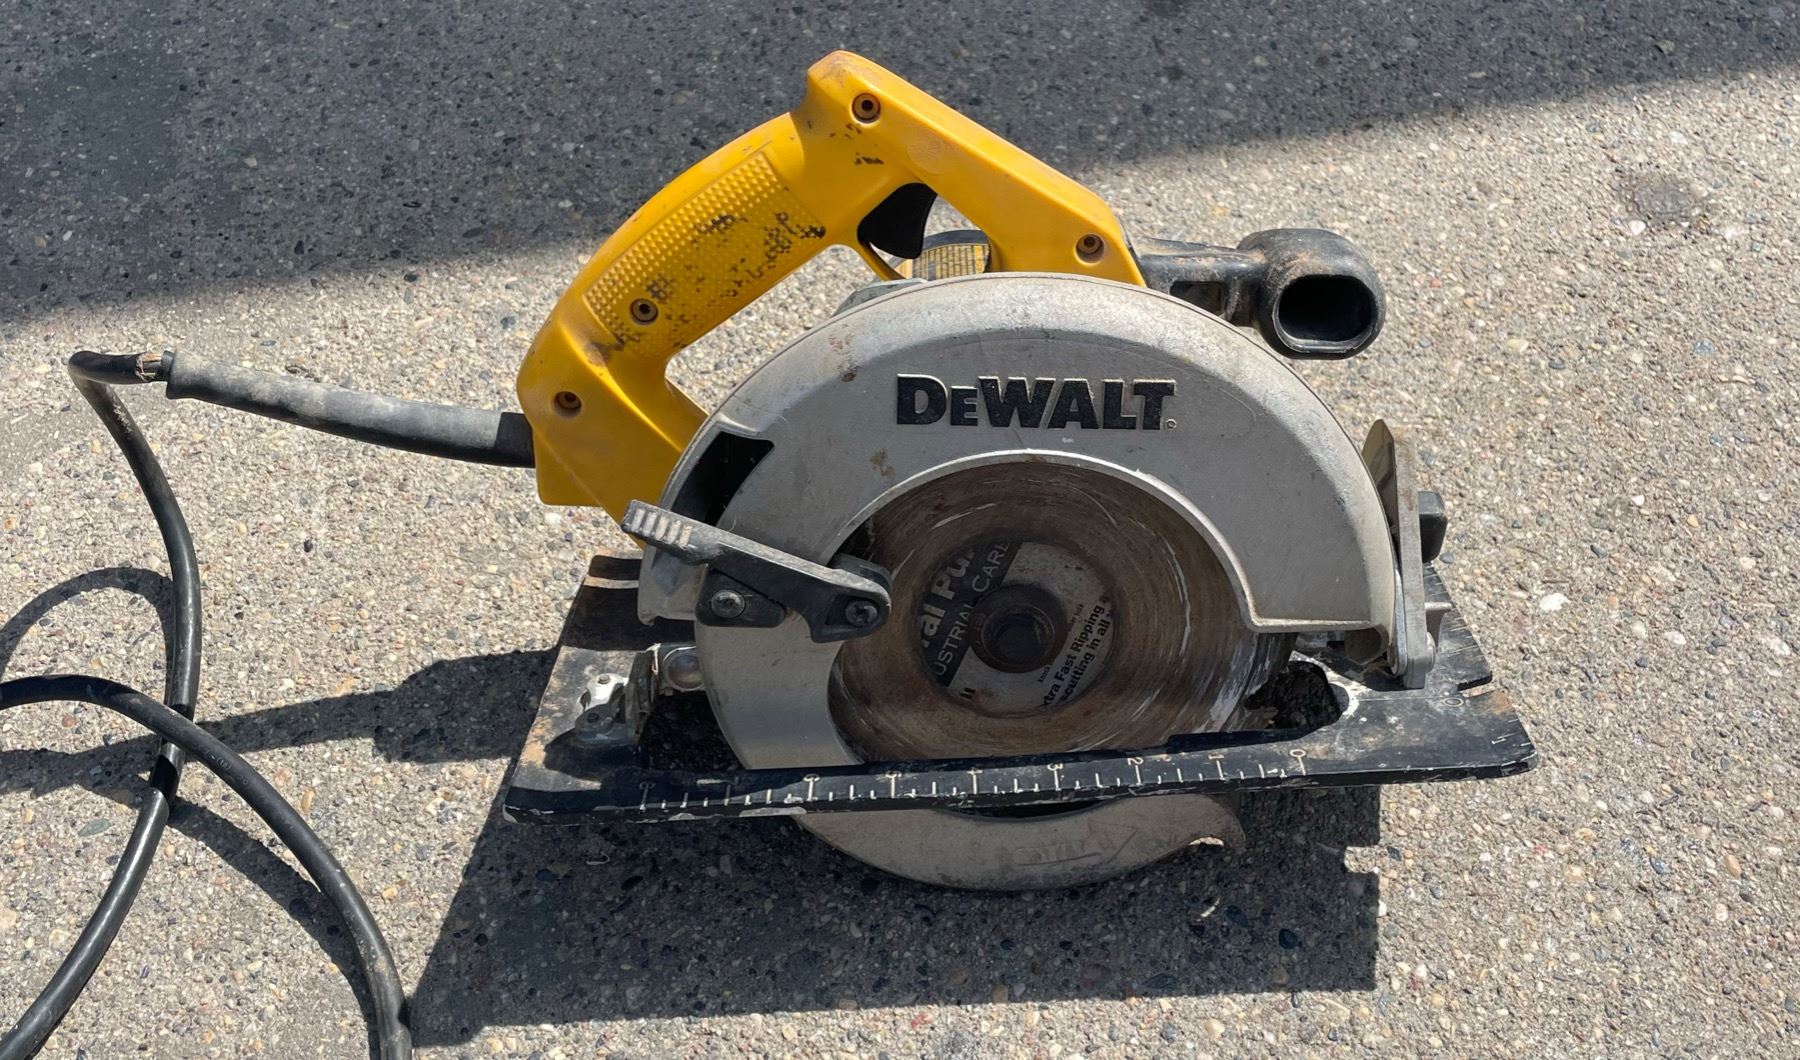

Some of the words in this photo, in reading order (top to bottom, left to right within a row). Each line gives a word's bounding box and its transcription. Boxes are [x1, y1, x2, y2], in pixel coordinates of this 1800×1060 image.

[1055, 654, 1077, 681] Fast
[1070, 605, 1105, 653] Ripping
[1086, 638, 1101, 651] in
[1097, 619, 1111, 637] all
